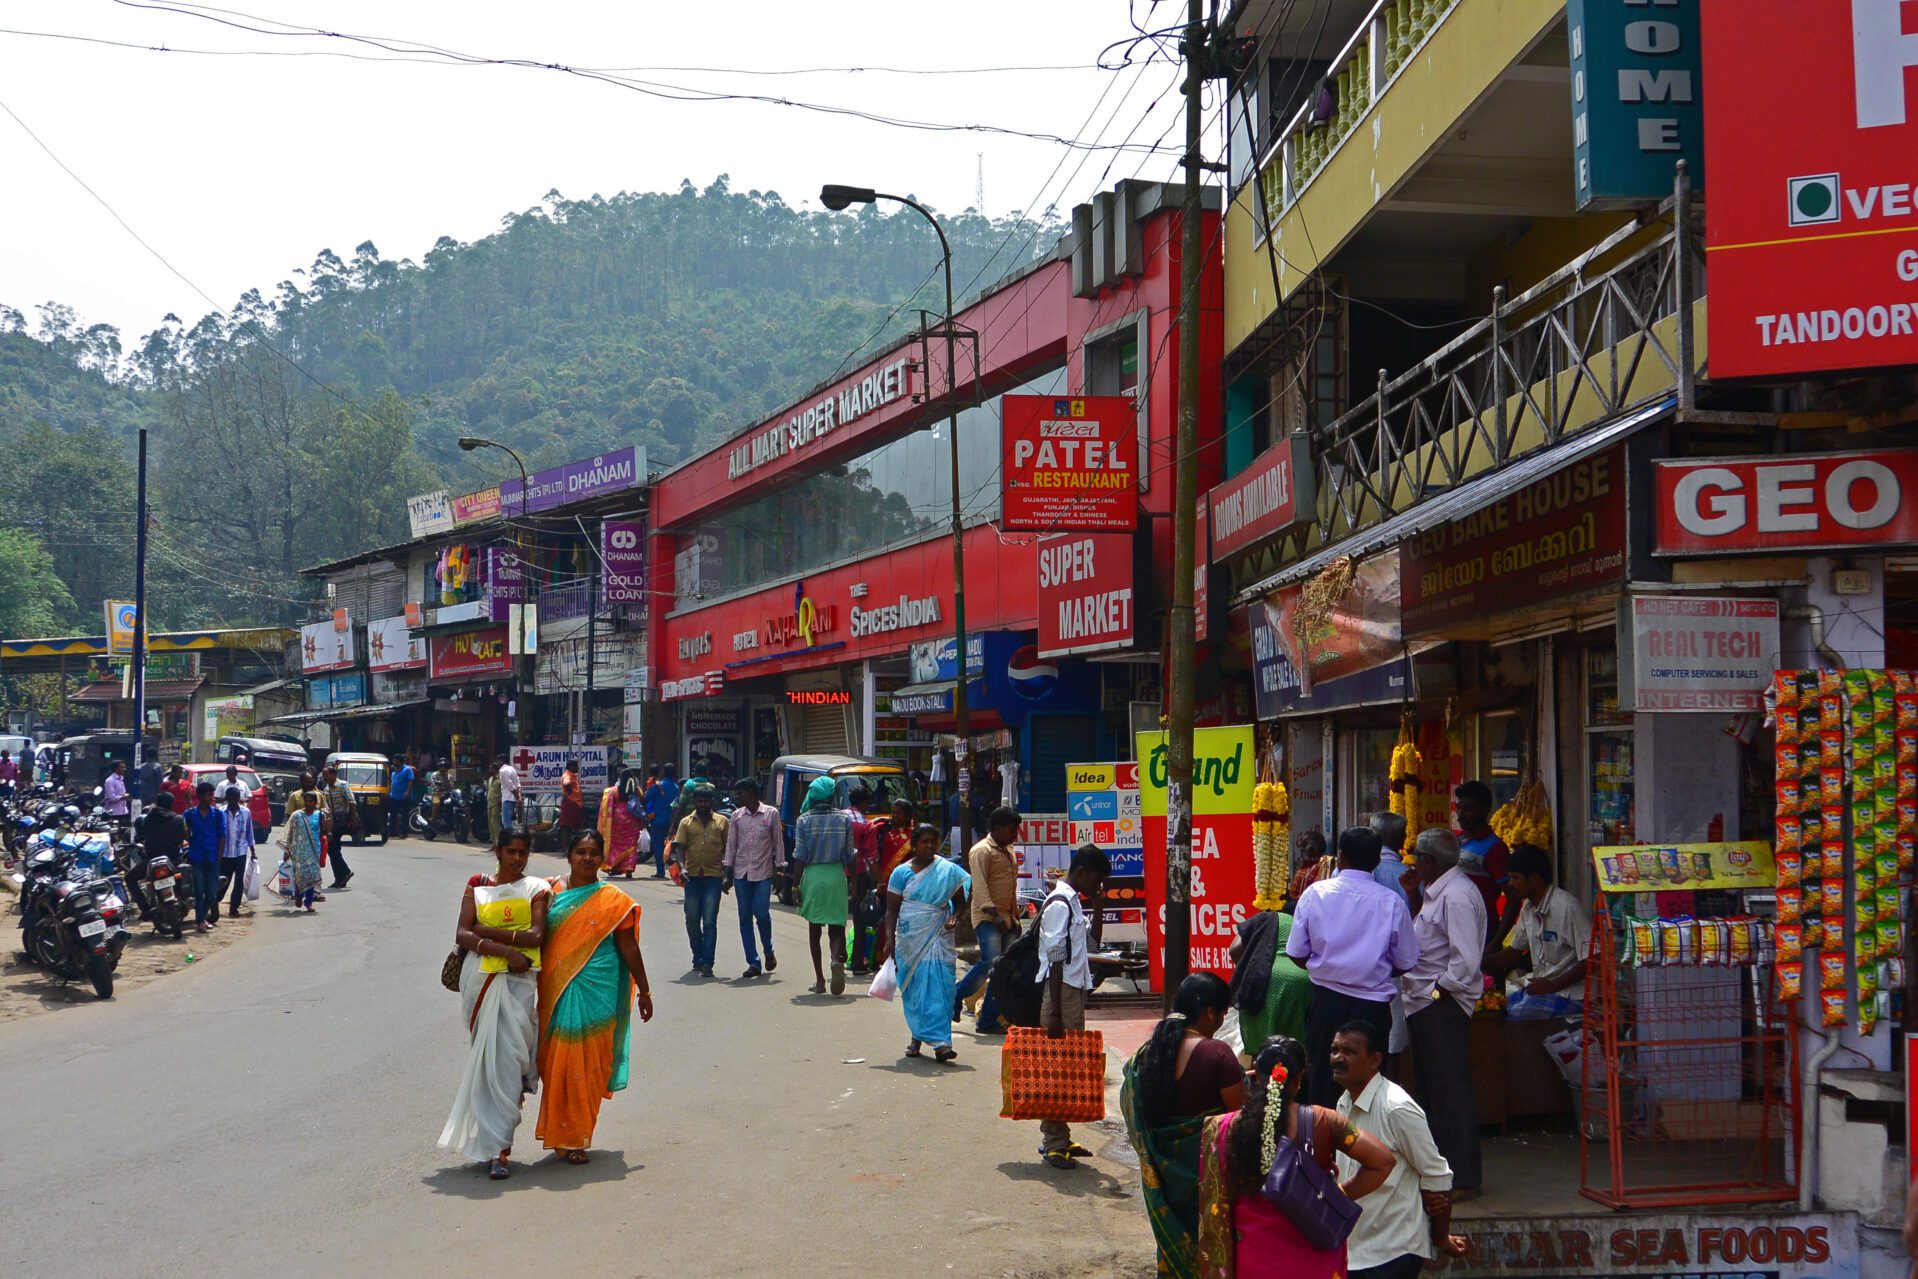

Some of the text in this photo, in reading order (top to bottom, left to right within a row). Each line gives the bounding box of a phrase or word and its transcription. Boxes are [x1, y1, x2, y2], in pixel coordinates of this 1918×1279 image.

[1617, 0, 1693, 150] OME
[728, 356, 911, 481] ALL MART SUPER MARKET
[1014, 440, 1127, 469] PATEL
[569, 460, 631, 492] DHANAM
[1034, 472, 1130, 488] RESTAURANT
[460, 493, 475, 508] CITY
[476, 487, 500, 503] QUEEN
[501, 491, 524, 505] MUNNAR
[525, 486, 541, 499] CHITS
[1215, 488, 1243, 543] ROOMS
[1243, 460, 1289, 527] AVAILABLE
[1674, 460, 1902, 538] GEO
[1408, 455, 1610, 562] GEO BAKE HOUSE
[607, 552, 642, 561] DHANAM
[1040, 538, 1095, 588] SUPER
[608, 575, 643, 585] GOLD
[850, 582, 868, 598] THE
[493, 586, 508, 598] CHITS
[608, 590, 643, 600] LOAN
[850, 595, 942, 638] SPICES INDIA
[1059, 588, 1131, 640] MARKET
[1660, 601, 1679, 612] NET
[1680, 601, 1707, 613] CAFE
[455, 633, 477, 655] HOT
[1648, 630, 1761, 659] REAL TECH
[1651, 669, 1760, 679] COMPUTER SERVICING & SALES
[909, 696, 927, 712] BOOK
[926, 695, 945, 710] STALL
[1639, 693, 1761, 708] INTERNET
[690, 722, 737, 730] CHOCOLATE
[691, 712, 737, 721] HOMEMADE
[536, 751, 561, 762] ARUN
[1091, 799, 1112, 809] uninor
[1191, 827, 1220, 859] EA
[1190, 865, 1206, 898] &
[1213, 947, 1220, 968] &
[1610, 1229, 1689, 1266] SEA
[1698, 1226, 1831, 1265] FOODS
